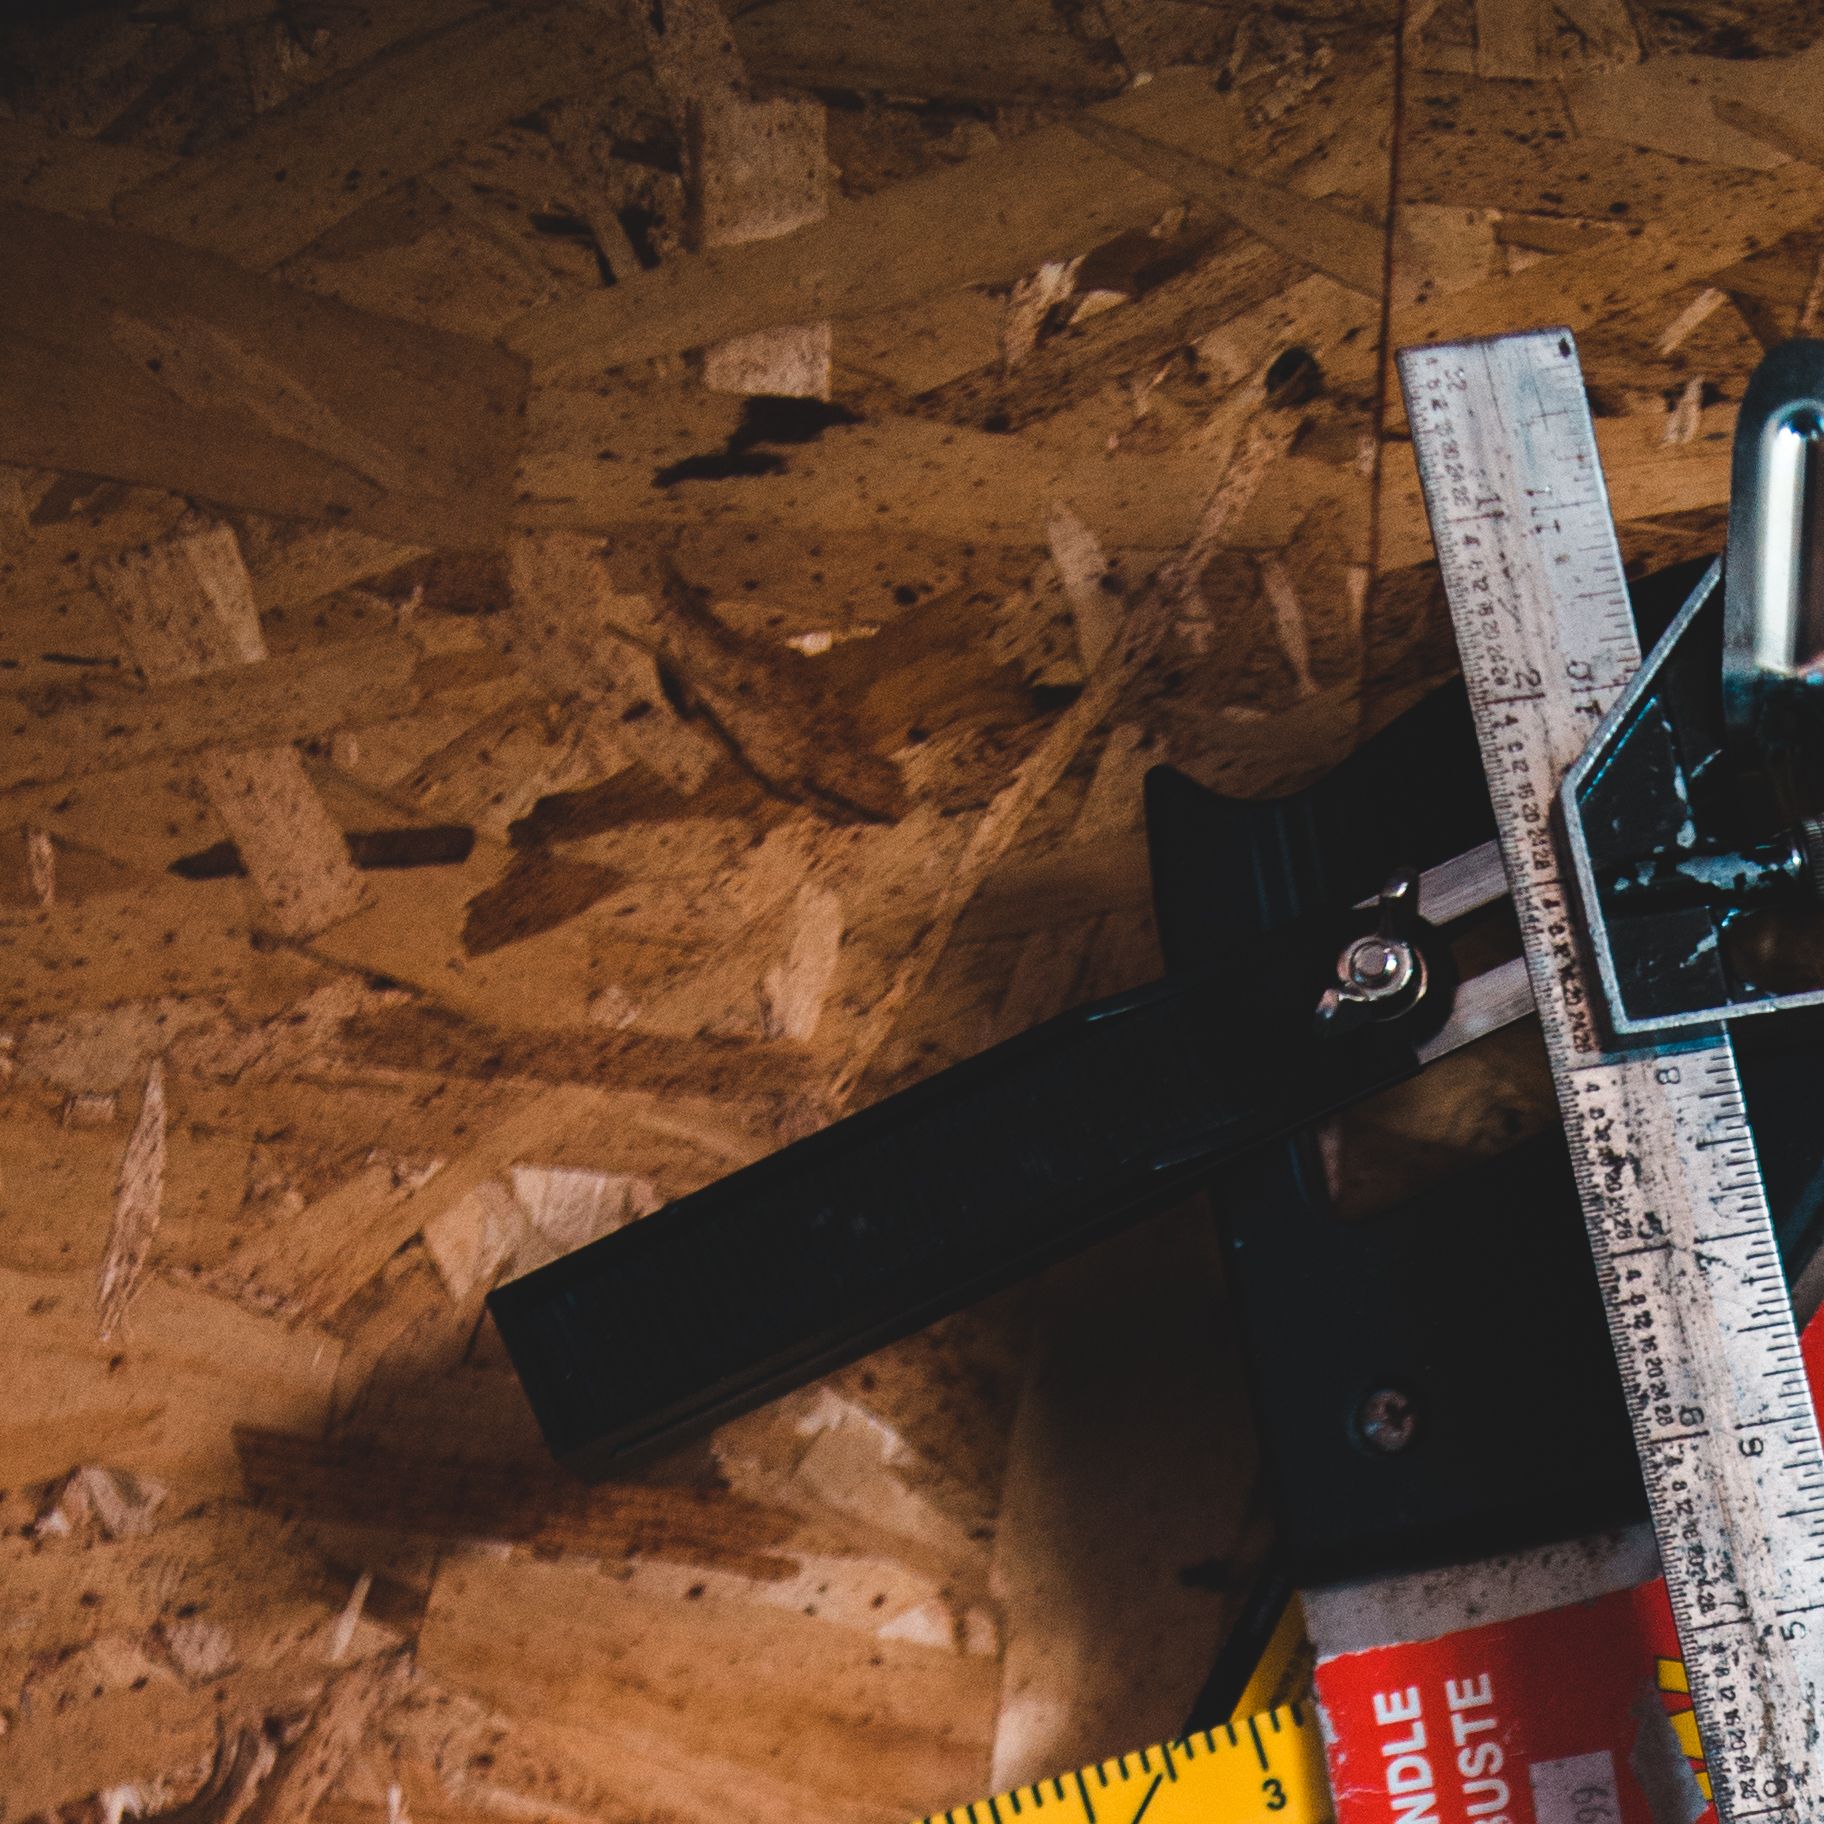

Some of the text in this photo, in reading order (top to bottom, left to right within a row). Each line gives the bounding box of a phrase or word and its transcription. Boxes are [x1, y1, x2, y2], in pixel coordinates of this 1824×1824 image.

[1511, 668, 1542, 689] 2
[1655, 1066, 1681, 1086] 8
[1678, 1405, 1704, 1427] 6
[1718, 1589, 1748, 1612] 7
[1780, 1620, 1807, 1641] 5
[1263, 1778, 1288, 1811] 3
[1761, 1777, 1788, 1798] 8
